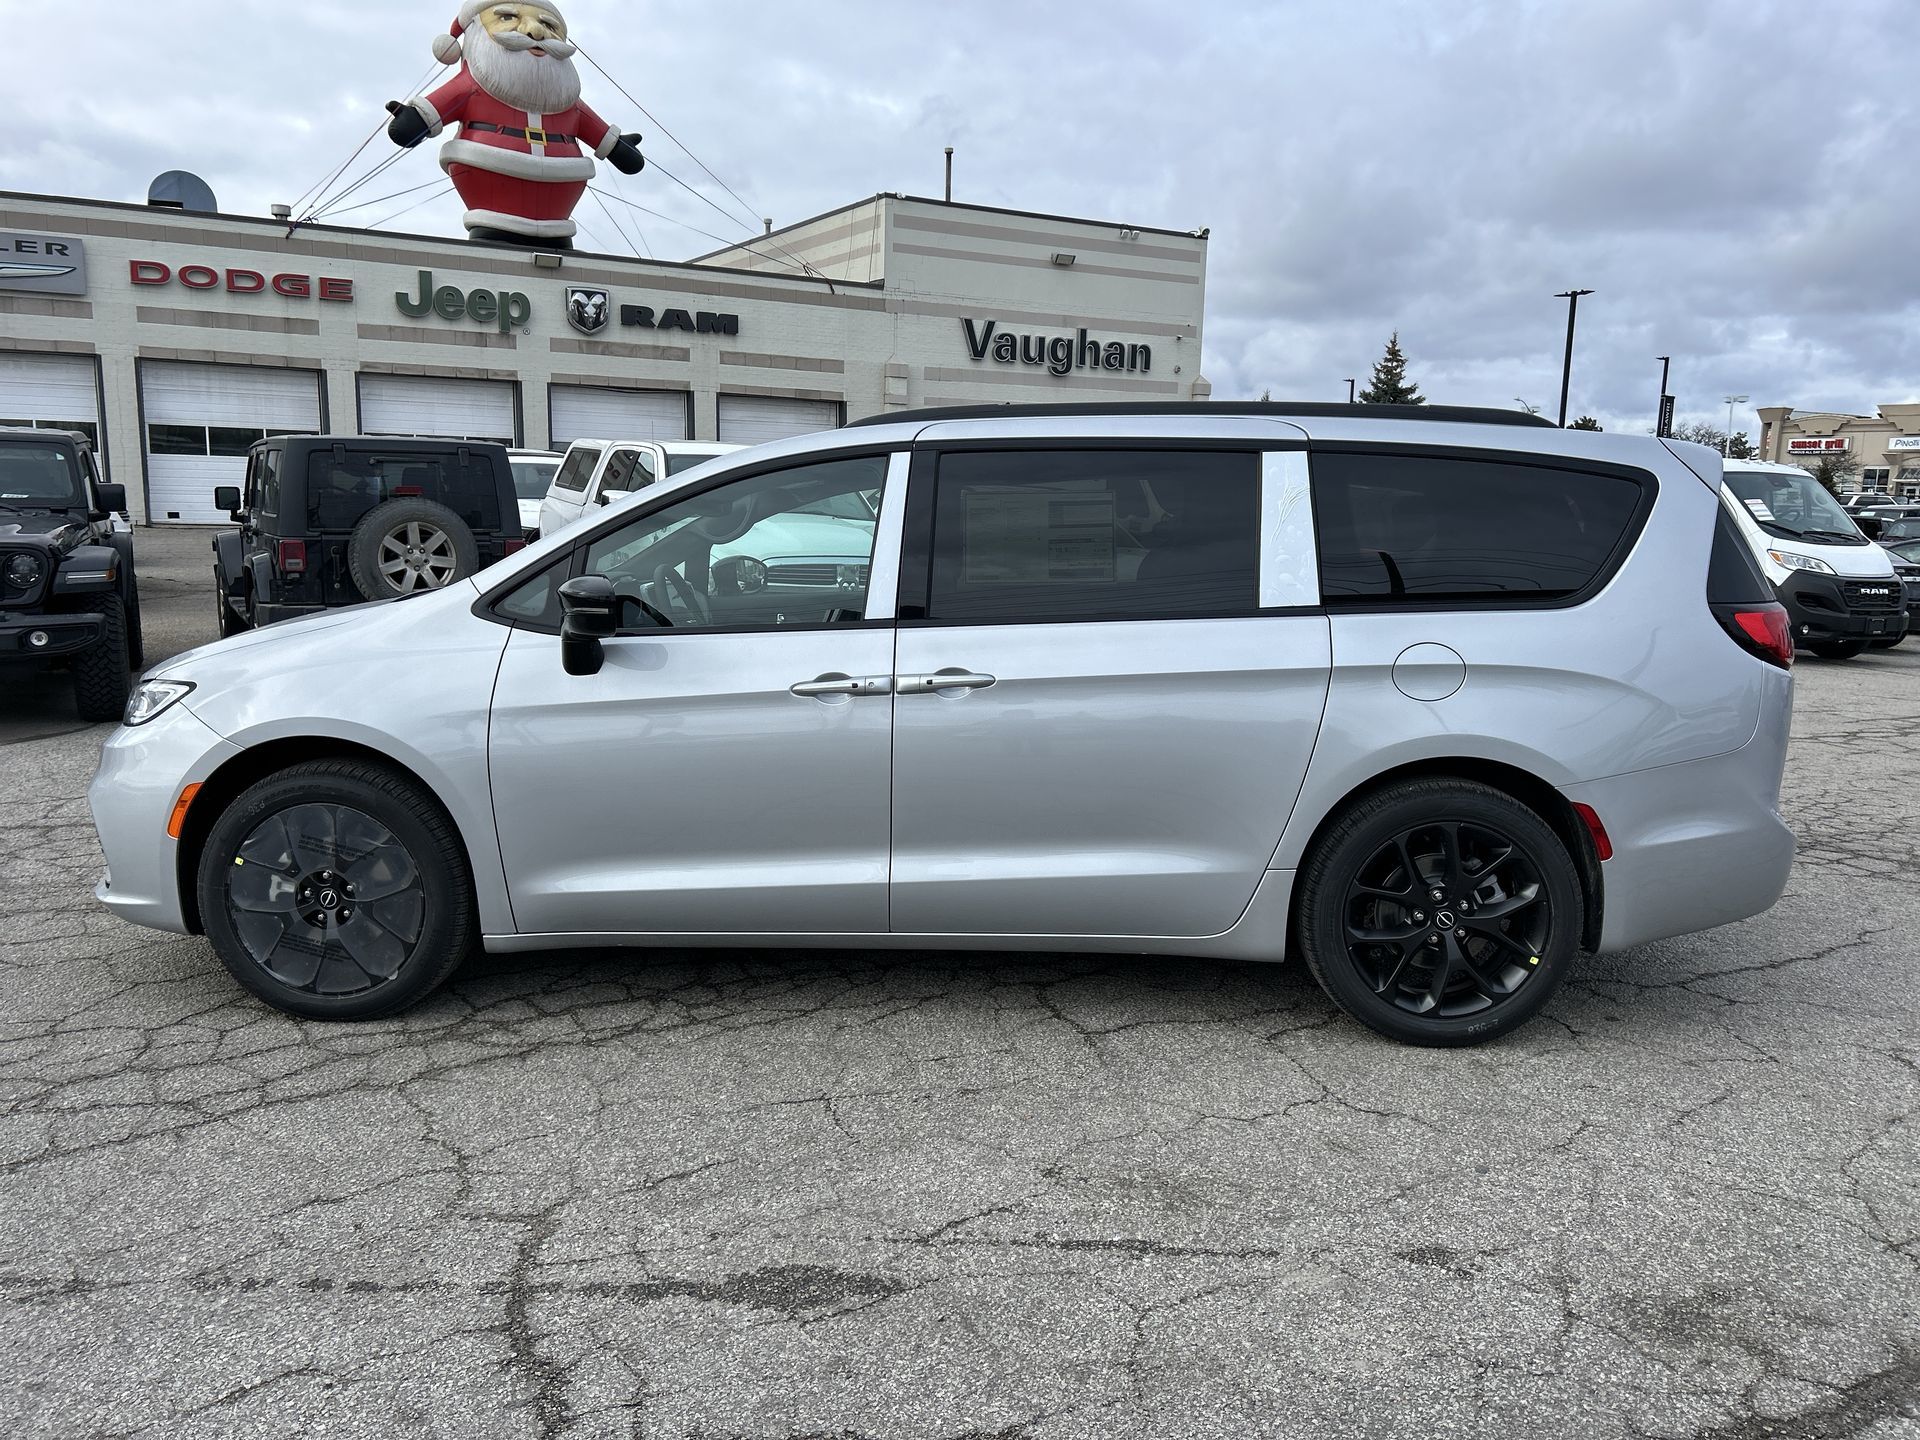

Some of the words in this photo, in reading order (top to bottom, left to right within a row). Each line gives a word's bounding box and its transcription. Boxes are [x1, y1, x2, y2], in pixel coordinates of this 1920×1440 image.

[129, 259, 354, 302] DODGE
[395, 269, 532, 332] Jeep
[620, 304, 739, 335] RAM
[959, 316, 1153, 377] Vaughan
[1790, 440, 1823, 449] sunset
[1825, 438, 1845, 449] grill
